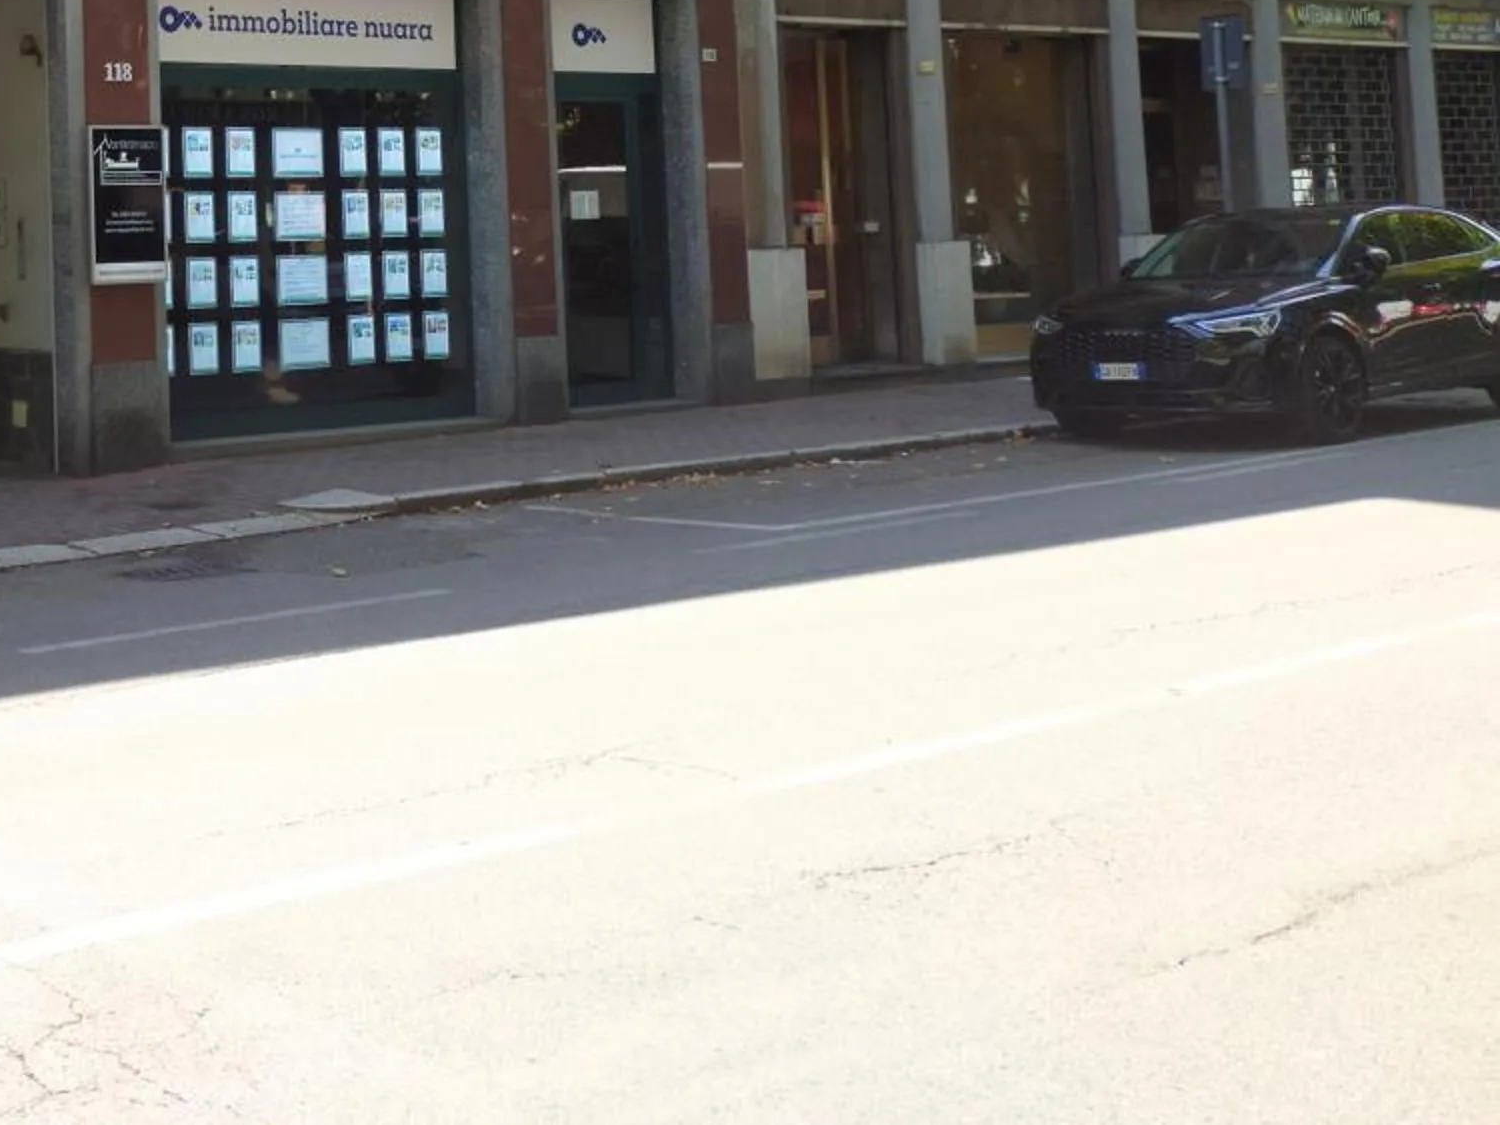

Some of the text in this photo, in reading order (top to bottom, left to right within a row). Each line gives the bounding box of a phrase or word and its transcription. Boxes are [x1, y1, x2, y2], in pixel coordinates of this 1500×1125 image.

[208, 6, 433, 41] immobiliare nuara
[104, 62, 132, 81] 118
